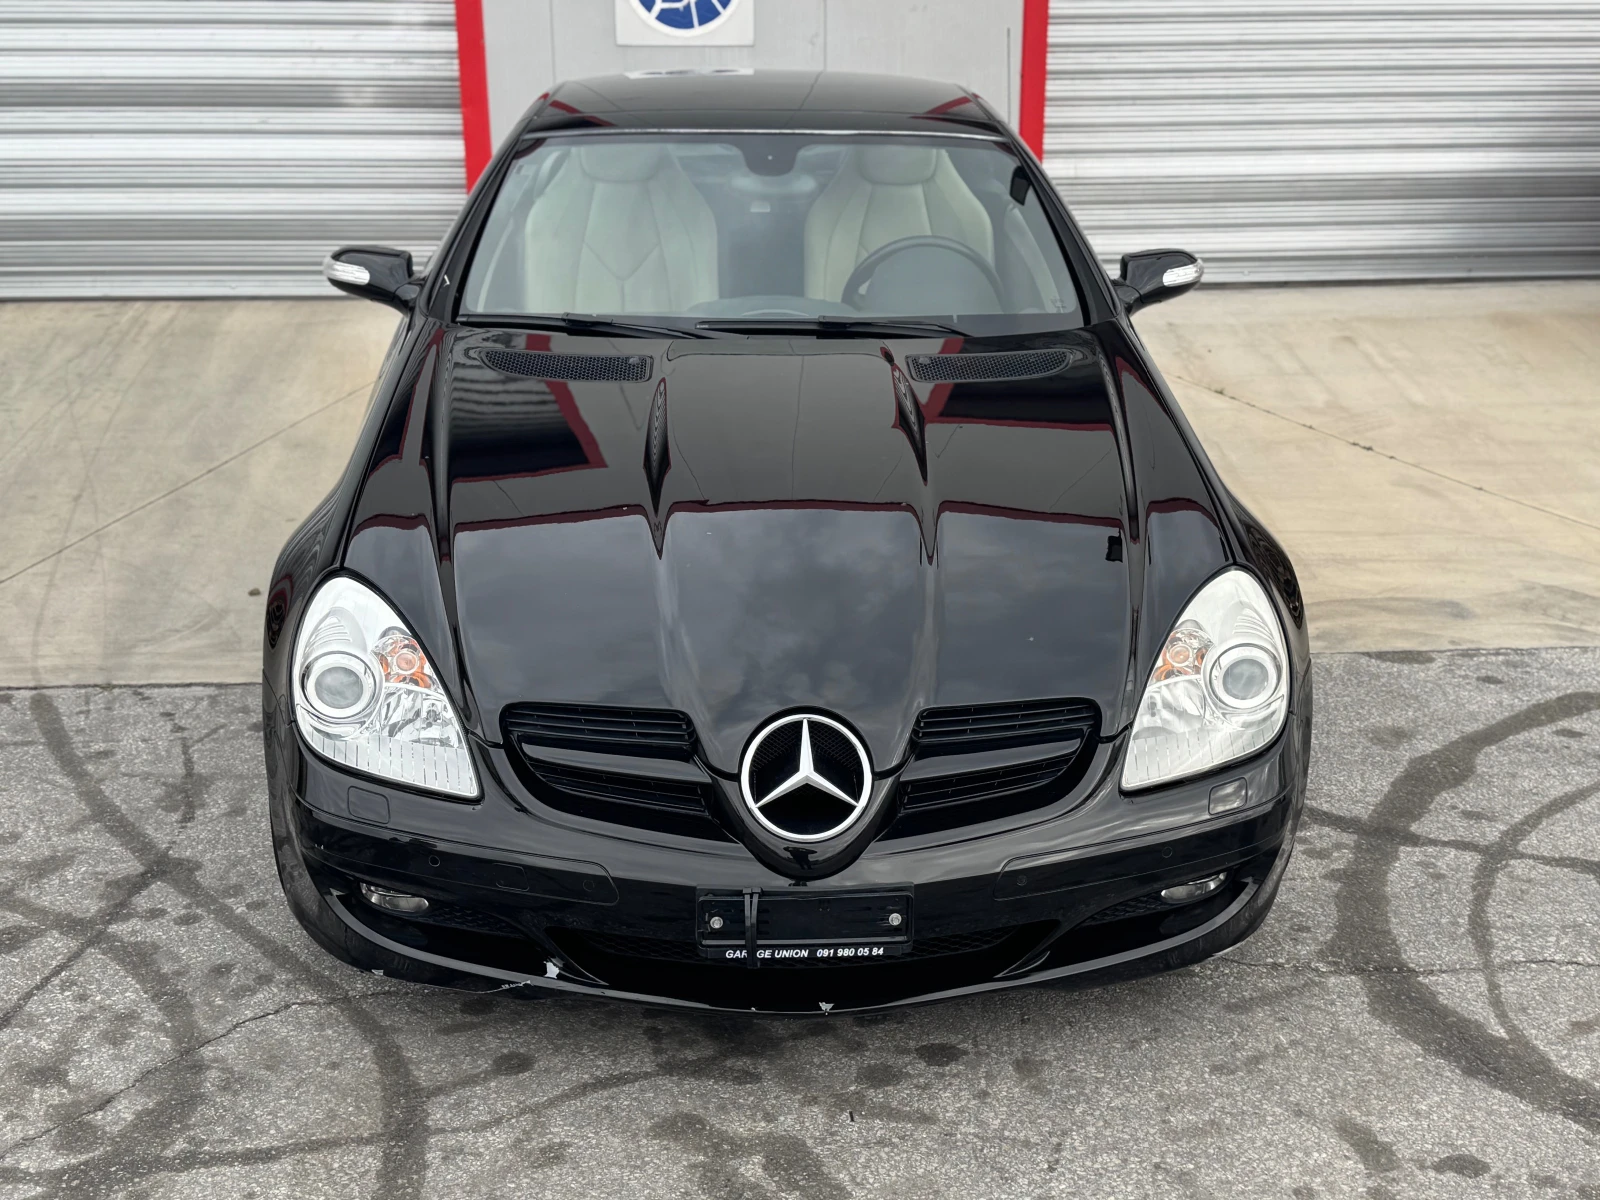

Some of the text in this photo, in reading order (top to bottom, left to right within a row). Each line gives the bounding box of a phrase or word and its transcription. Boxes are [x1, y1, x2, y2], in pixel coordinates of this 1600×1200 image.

[725, 947, 884, 958] GARGE UNION 091 980 05 84
